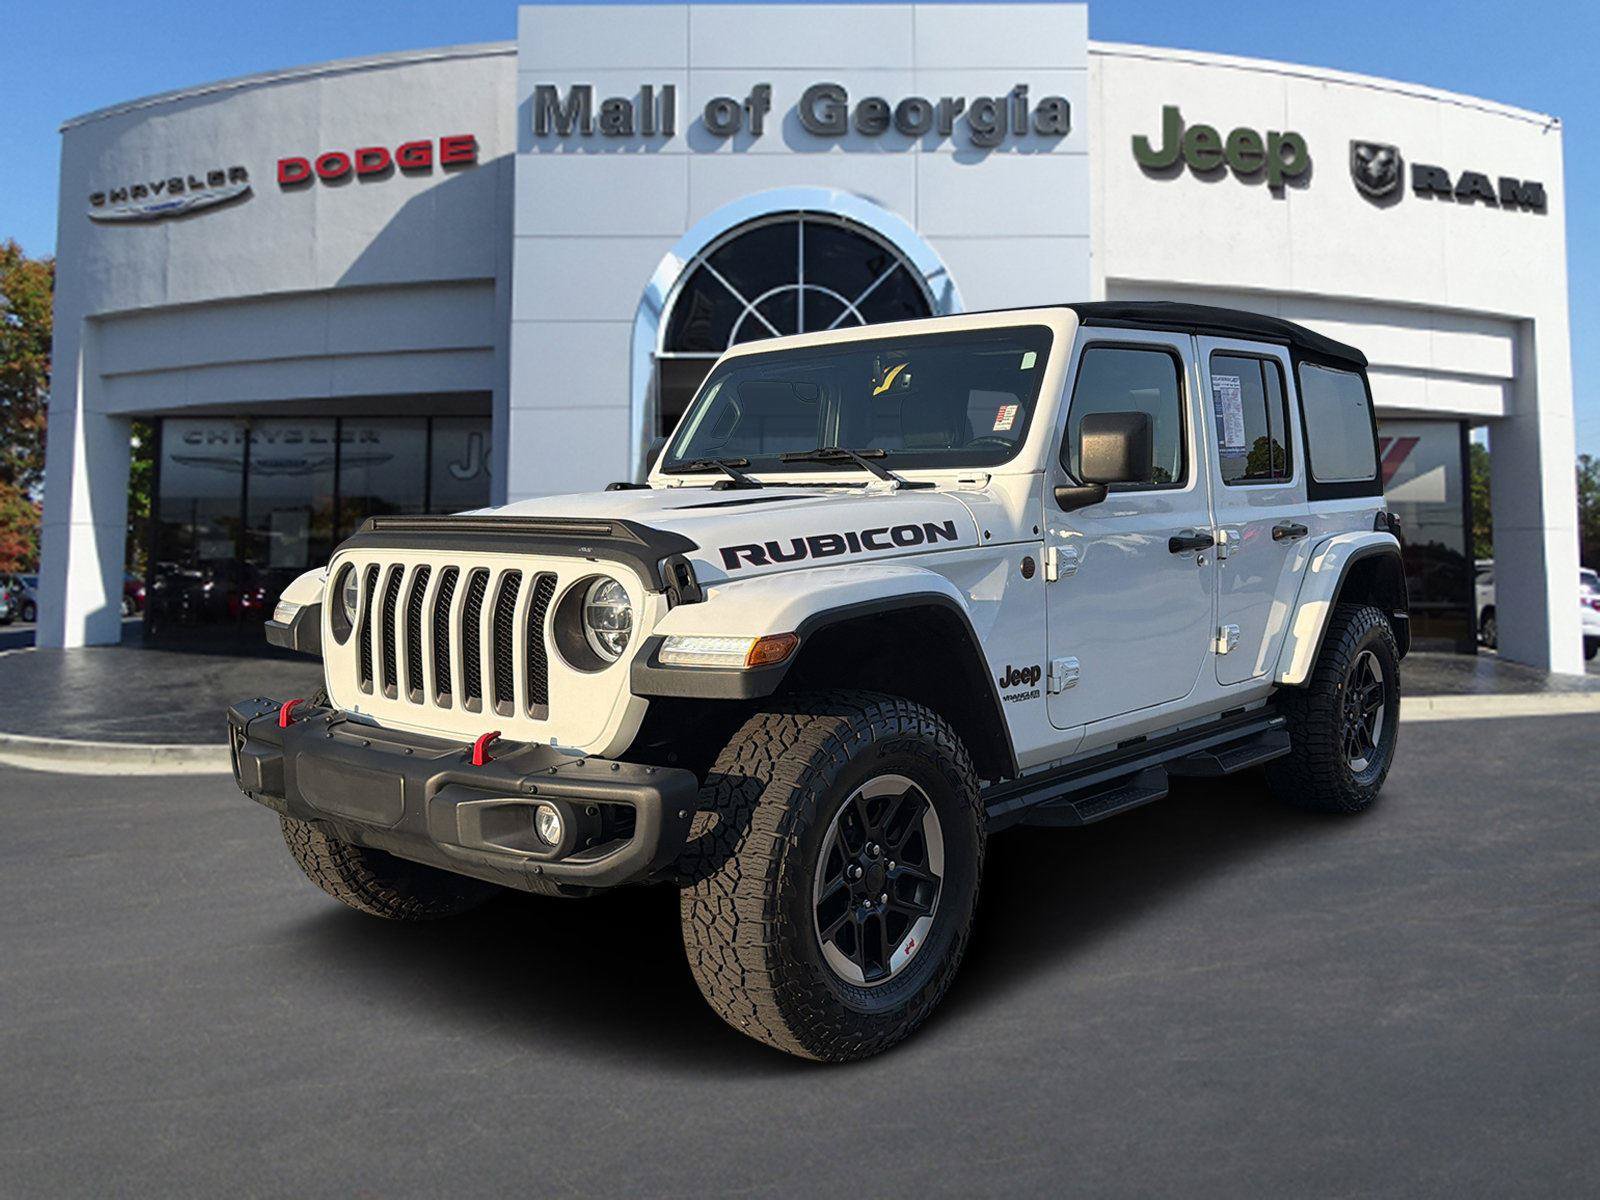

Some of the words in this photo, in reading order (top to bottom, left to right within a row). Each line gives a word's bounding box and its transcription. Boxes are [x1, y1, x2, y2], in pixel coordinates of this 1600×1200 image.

[533, 84, 676, 138] Mall
[704, 84, 773, 138] of
[800, 83, 1072, 148] Georgia
[277, 134, 477, 185] DODGE
[1132, 105, 1309, 190] Jeep
[89, 166, 249, 207] CHRYSLER
[1411, 162, 1546, 212] RAM
[719, 520, 958, 571] RUBICON
[999, 664, 1041, 688] Jeep
